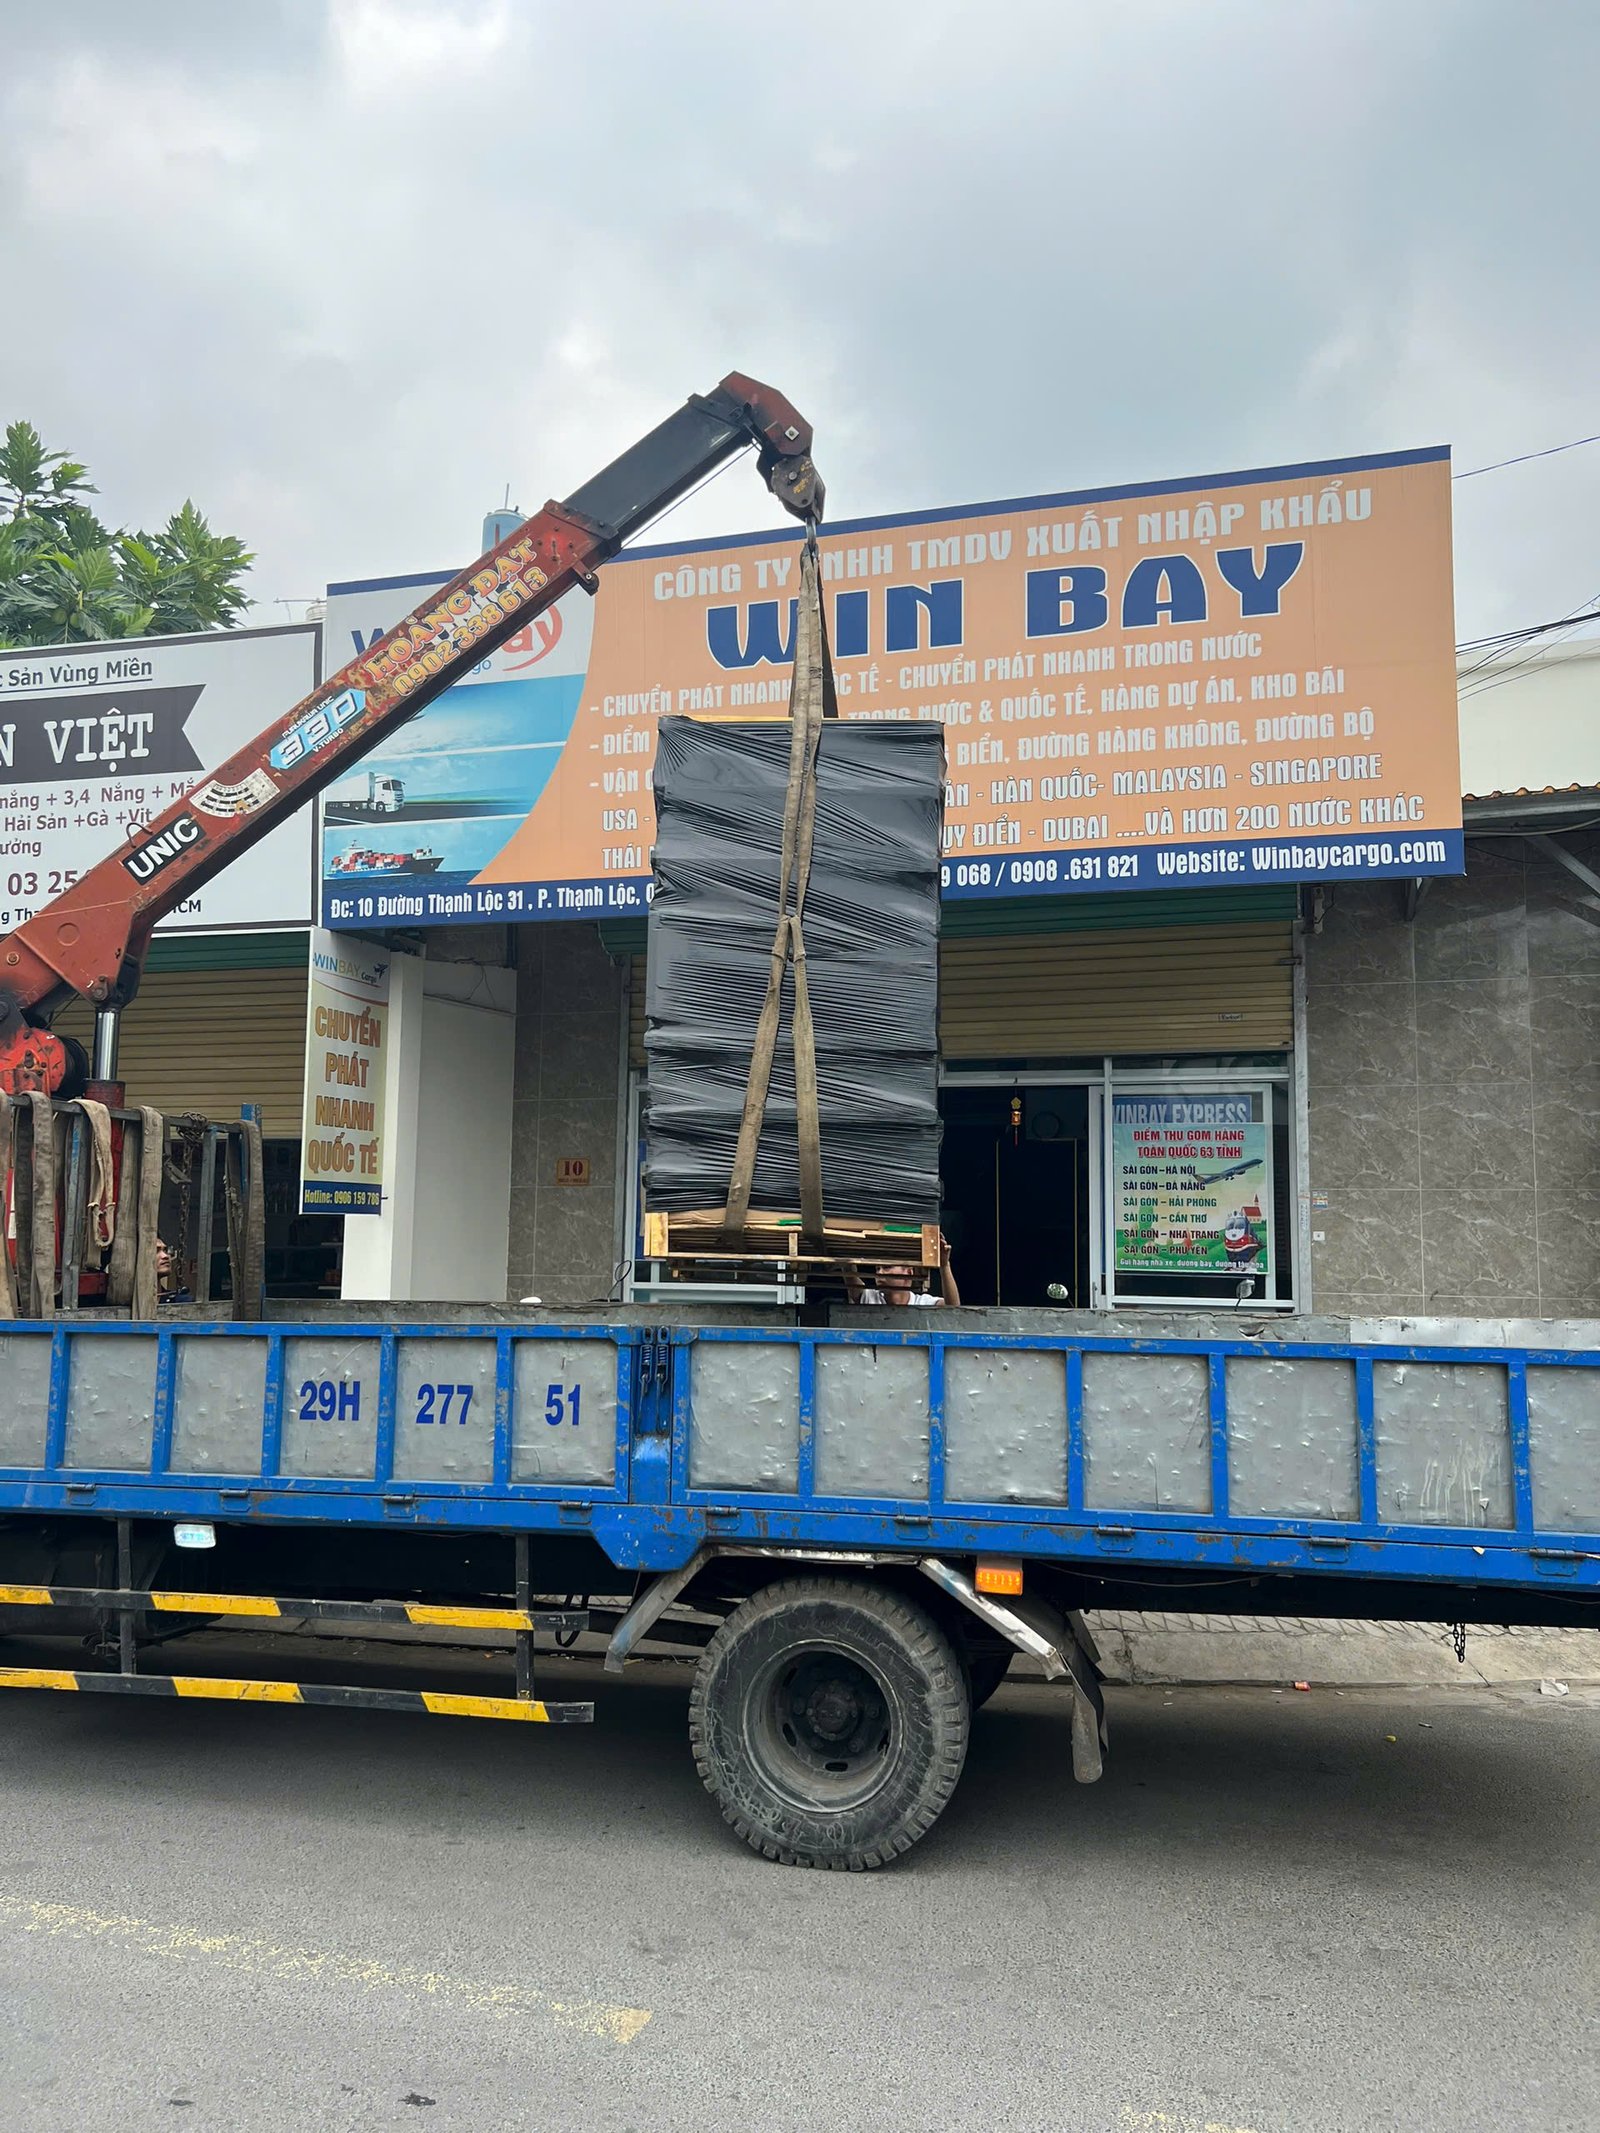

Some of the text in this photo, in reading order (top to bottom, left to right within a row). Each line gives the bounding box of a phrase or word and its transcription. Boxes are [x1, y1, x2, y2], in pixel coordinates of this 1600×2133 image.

[653, 480, 1372, 600] CÔNG TY NHH TMDV XUẤT NHẬP KHẨU
[364, 537, 537, 682] HOÀNG ĐẠT
[706, 540, 1305, 671] WIN BAY
[9, 667, 43, 687] Sản
[50, 664, 99, 684] Vùng
[106, 658, 152, 679] Miền
[603, 684, 673, 718] CHUYỂN
[678, 682, 725, 711] PHÁT
[730, 678, 793, 706] NHANH
[857, 663, 880, 693] TẾ
[900, 653, 977, 690] CHUYỂN
[984, 652, 1036, 681] PHÁT
[1043, 646, 1116, 676] NHANH
[1123, 638, 1194, 669] TRONG
[1201, 630, 1263, 662] NƯỚC
[978, 700, 994, 723] &
[1000, 688, 1057, 722] QUỐC
[1063, 683, 1094, 716] TẾ,
[1101, 683, 1160, 713] HÀNG
[1167, 679, 1199, 711] DỰ
[1205, 675, 1243, 704] ÁN,
[1251, 672, 1297, 700] KHO
[1305, 665, 1345, 696] BÃI
[43, 708, 154, 772] VIỆT
[279, 692, 357, 766] 330
[603, 724, 650, 756] ĐIỂM
[957, 731, 1010, 767] BIỂN,
[1017, 730, 1090, 762] ĐƯỜNG
[1098, 725, 1157, 755] HÀNG
[1164, 718, 1248, 750] KHÔNG,
[1255, 711, 1335, 744] ĐƯỜNG
[1343, 706, 1375, 742] BỘ
[64, 790, 90, 807] 3,4
[101, 783, 145, 803] Nắng
[171, 777, 196, 798] Mắ
[603, 768, 639, 798] VẬN
[944, 779, 969, 808] ẢN
[991, 775, 1034, 805] HÀN
[1112, 764, 1228, 797] MALAYSIA
[1250, 753, 1383, 787] SINGAPORE
[5, 814, 31, 832] Hải
[36, 813, 67, 831] Sản
[603, 808, 638, 832] USA
[973, 813, 1021, 848] ĐIỂN
[1043, 815, 1109, 842] DUBAI
[1182, 805, 1228, 834] HƠN
[1235, 804, 1281, 831] 200
[1288, 795, 1352, 828] NƯỚC
[1359, 791, 1425, 824] KHÁC
[0, 841, 42, 857] ưởng
[127, 817, 199, 878] UNIC
[602, 843, 642, 870] THÁI
[957, 863, 992, 888] 068
[1010, 859, 1058, 884] 0908
[1107, 854, 1139, 878] 821
[1156, 844, 1246, 876] Website:
[1251, 839, 1447, 872] Winbaycargo.com
[7, 872, 39, 896] 03
[331, 898, 354, 918] Đc:
[358, 898, 373, 918] 10
[377, 893, 424, 918] Đường
[427, 893, 473, 918] Thạnh
[477, 889, 503, 917] Lộc
[507, 889, 523, 911] 31
[537, 888, 552, 909] P.
[557, 884, 604, 912] Thạnh
[608, 883, 642, 911] Lộc,
[173, 899, 202, 914] CM
[315, 1006, 382, 1048] CHUYỂN
[325, 1051, 370, 1088] PHÁT
[315, 1095, 375, 1132] NHANH
[1172, 1102, 1247, 1124] EXPRESS
[308, 1132, 379, 1174] QUỐC TẾ
[1133, 1127, 1245, 1142] ĐIỂM THU GOM HÀNG
[1168, 1143, 1198, 1159] QUỐC
[1200, 1146, 1214, 1158] 63
[563, 1160, 583, 1176] 10
[1169, 1230, 1188, 1239] NHA
[1191, 1230, 1219, 1239] TRANG
[299, 1380, 581, 1426] 29H 277 51
